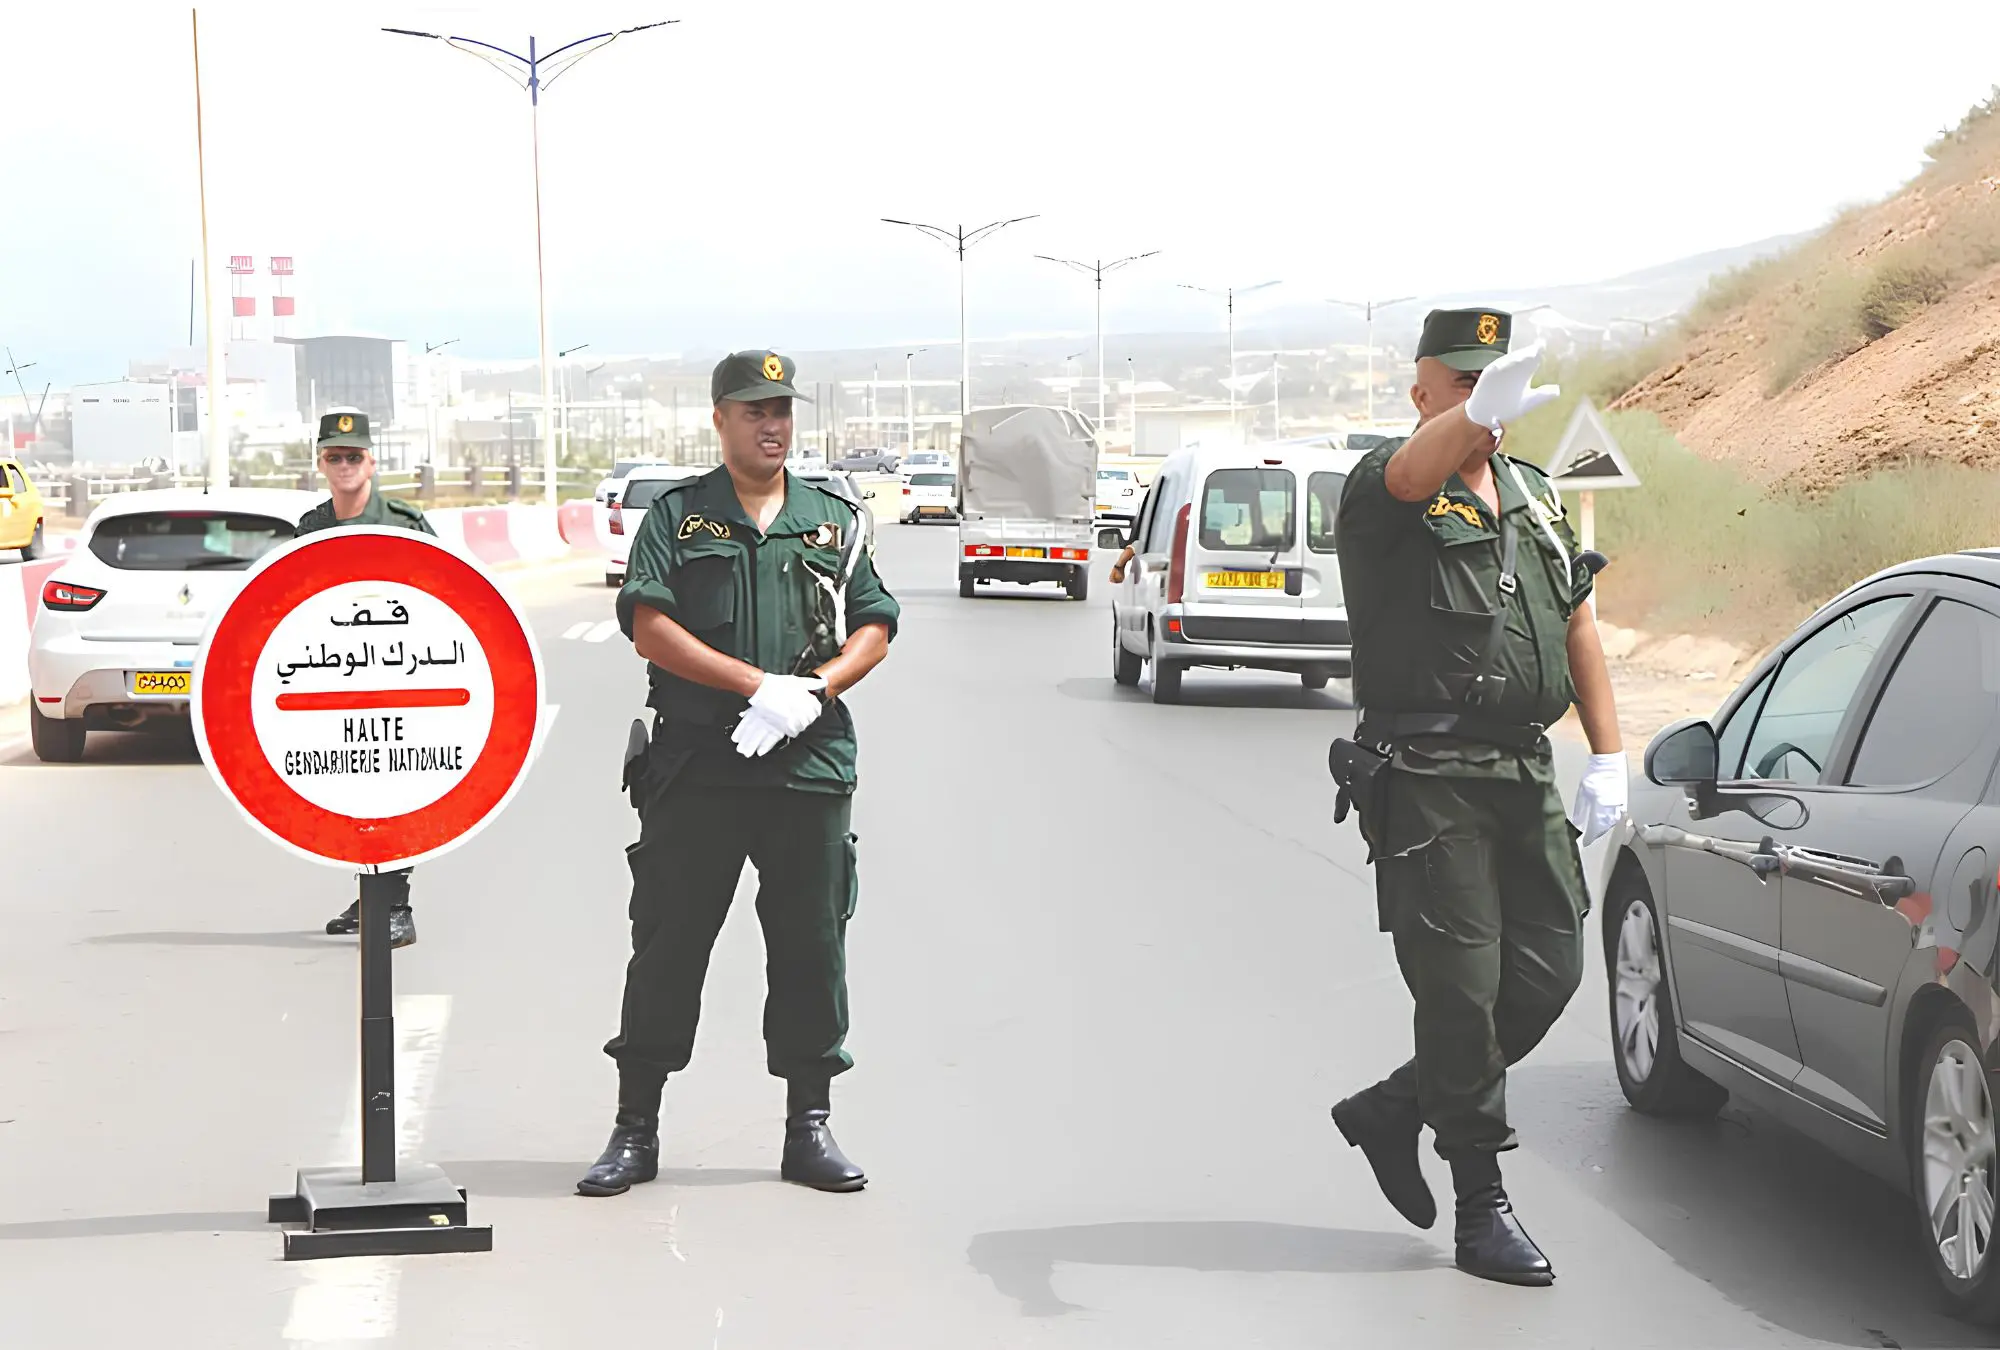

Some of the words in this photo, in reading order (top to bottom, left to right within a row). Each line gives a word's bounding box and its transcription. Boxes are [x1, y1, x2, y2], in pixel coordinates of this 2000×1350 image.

[277, 642, 375, 685] الوطني
[381, 640, 465, 676] الدرك
[343, 716, 404, 743] HALTE
[388, 745, 463, 772] NATIONALE
